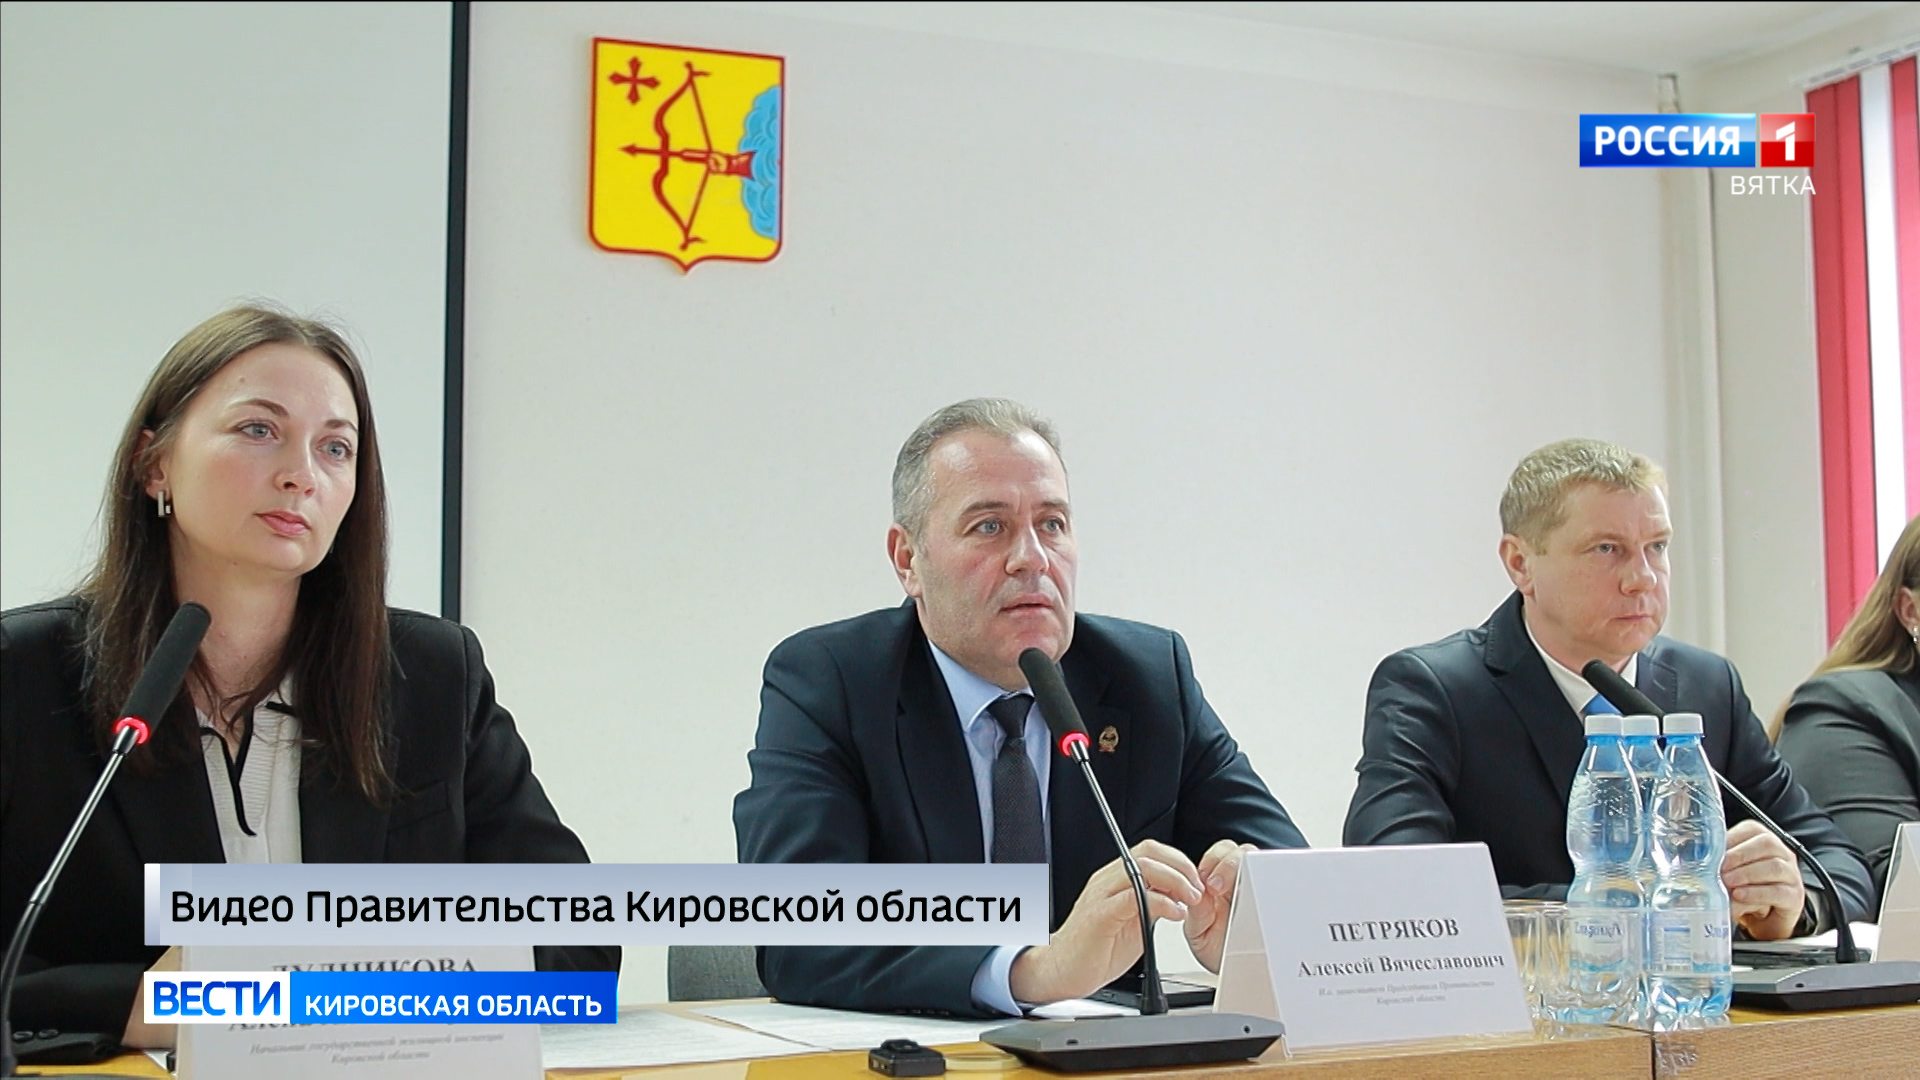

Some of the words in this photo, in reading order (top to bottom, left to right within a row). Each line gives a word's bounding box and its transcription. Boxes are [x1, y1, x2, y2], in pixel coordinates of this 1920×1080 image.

[1328, 919, 1460, 942] ПЕТРЯКОВ
[1298, 957, 1375, 977] Алексей
[1379, 954, 1505, 973] Вячеславович
